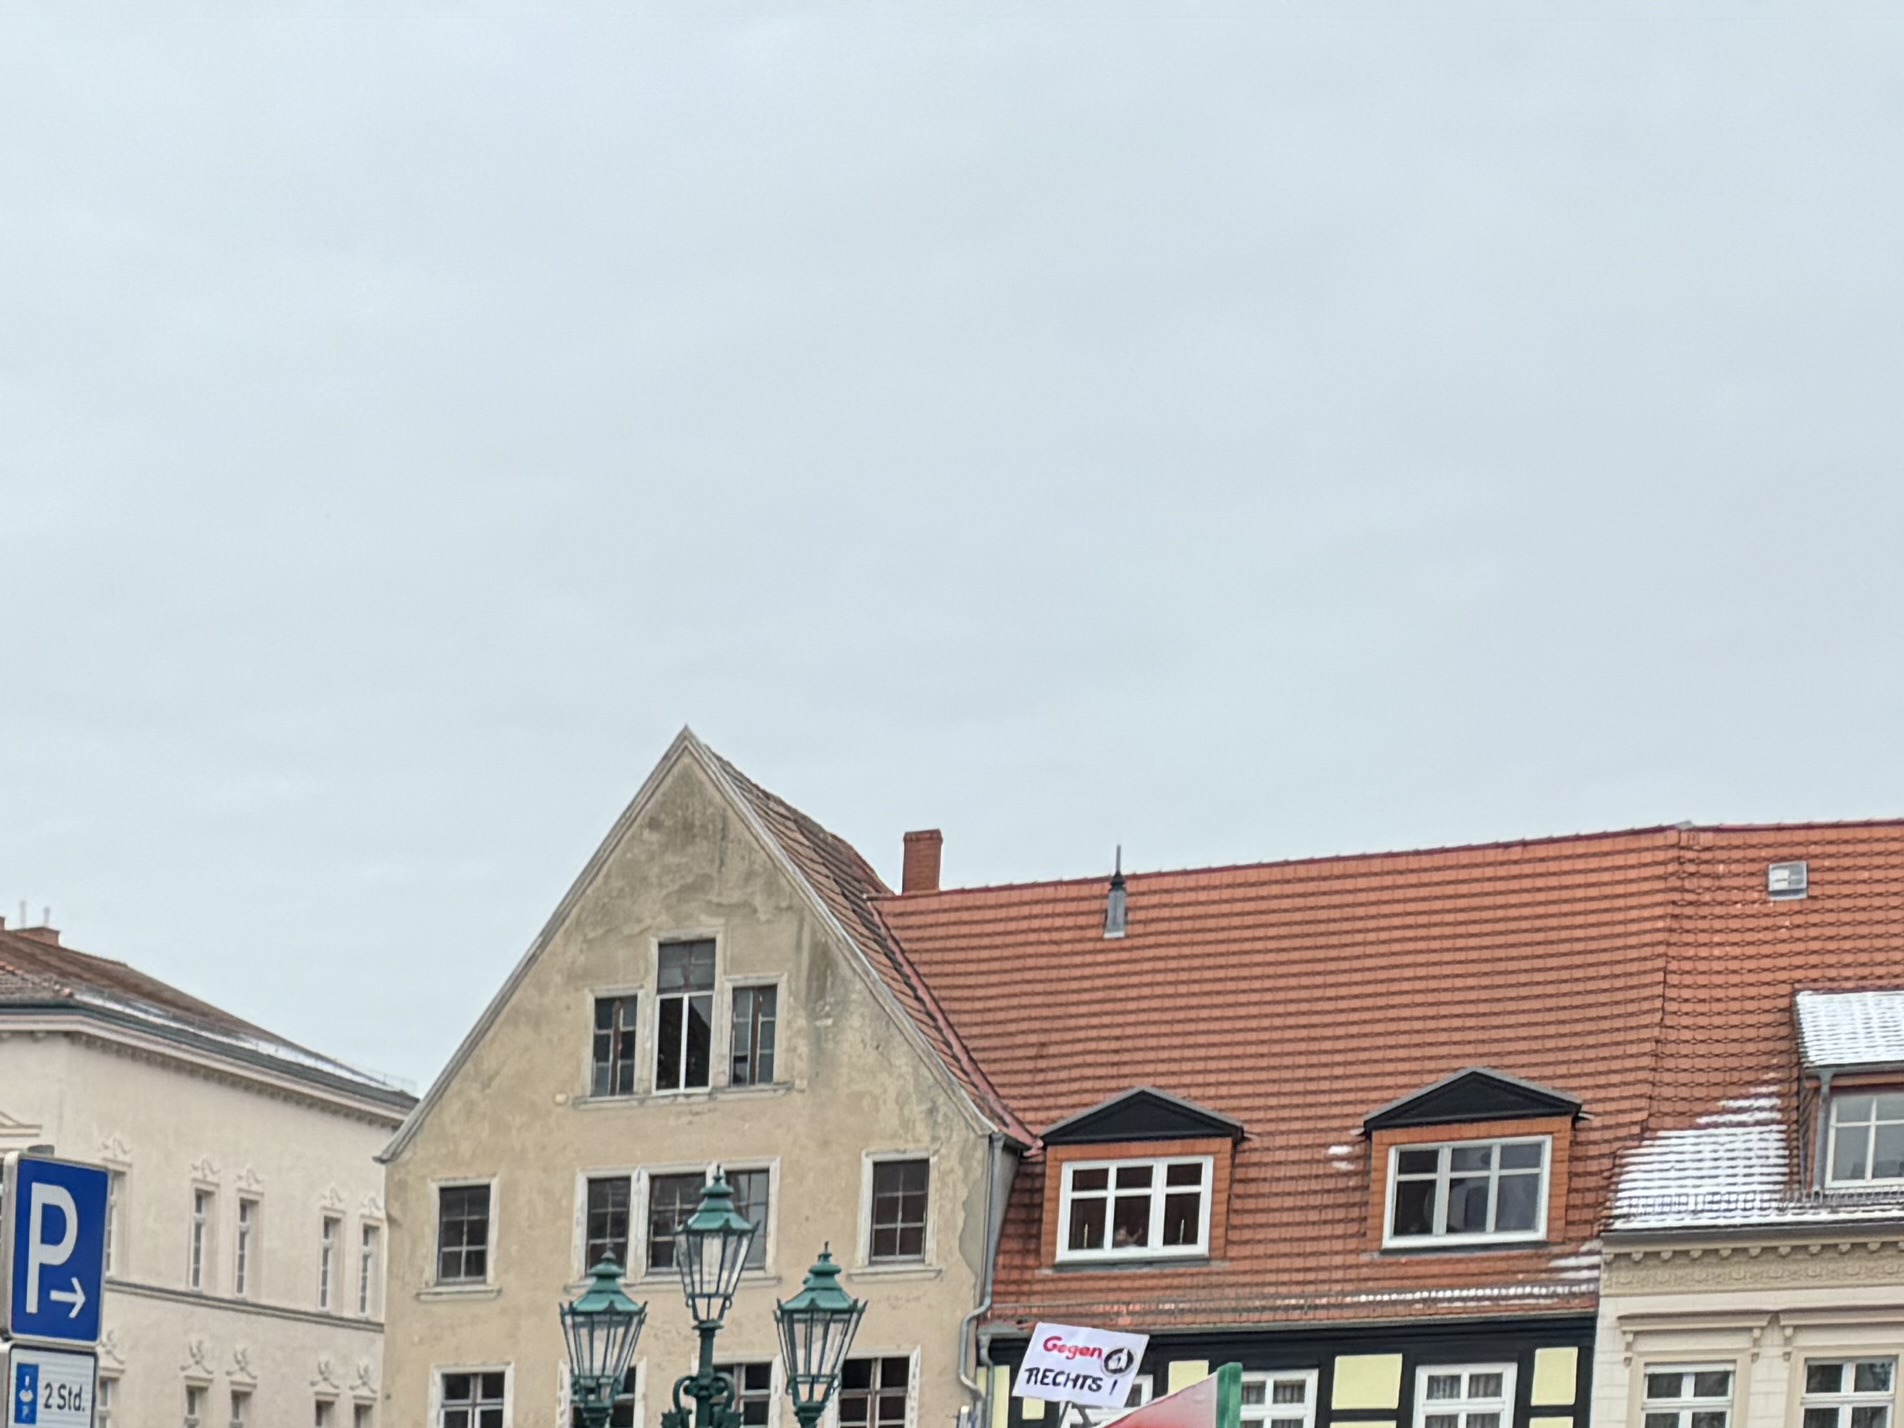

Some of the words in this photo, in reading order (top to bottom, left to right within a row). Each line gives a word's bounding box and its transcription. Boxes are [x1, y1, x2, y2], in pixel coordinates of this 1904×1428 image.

[26, 1182, 78, 1314] P
[1043, 1336, 1103, 1360] Gegen
[1024, 1367, 1103, 1392] RECHTS
[44, 1382, 52, 1410] 2
[57, 1384, 86, 1412] Std.
